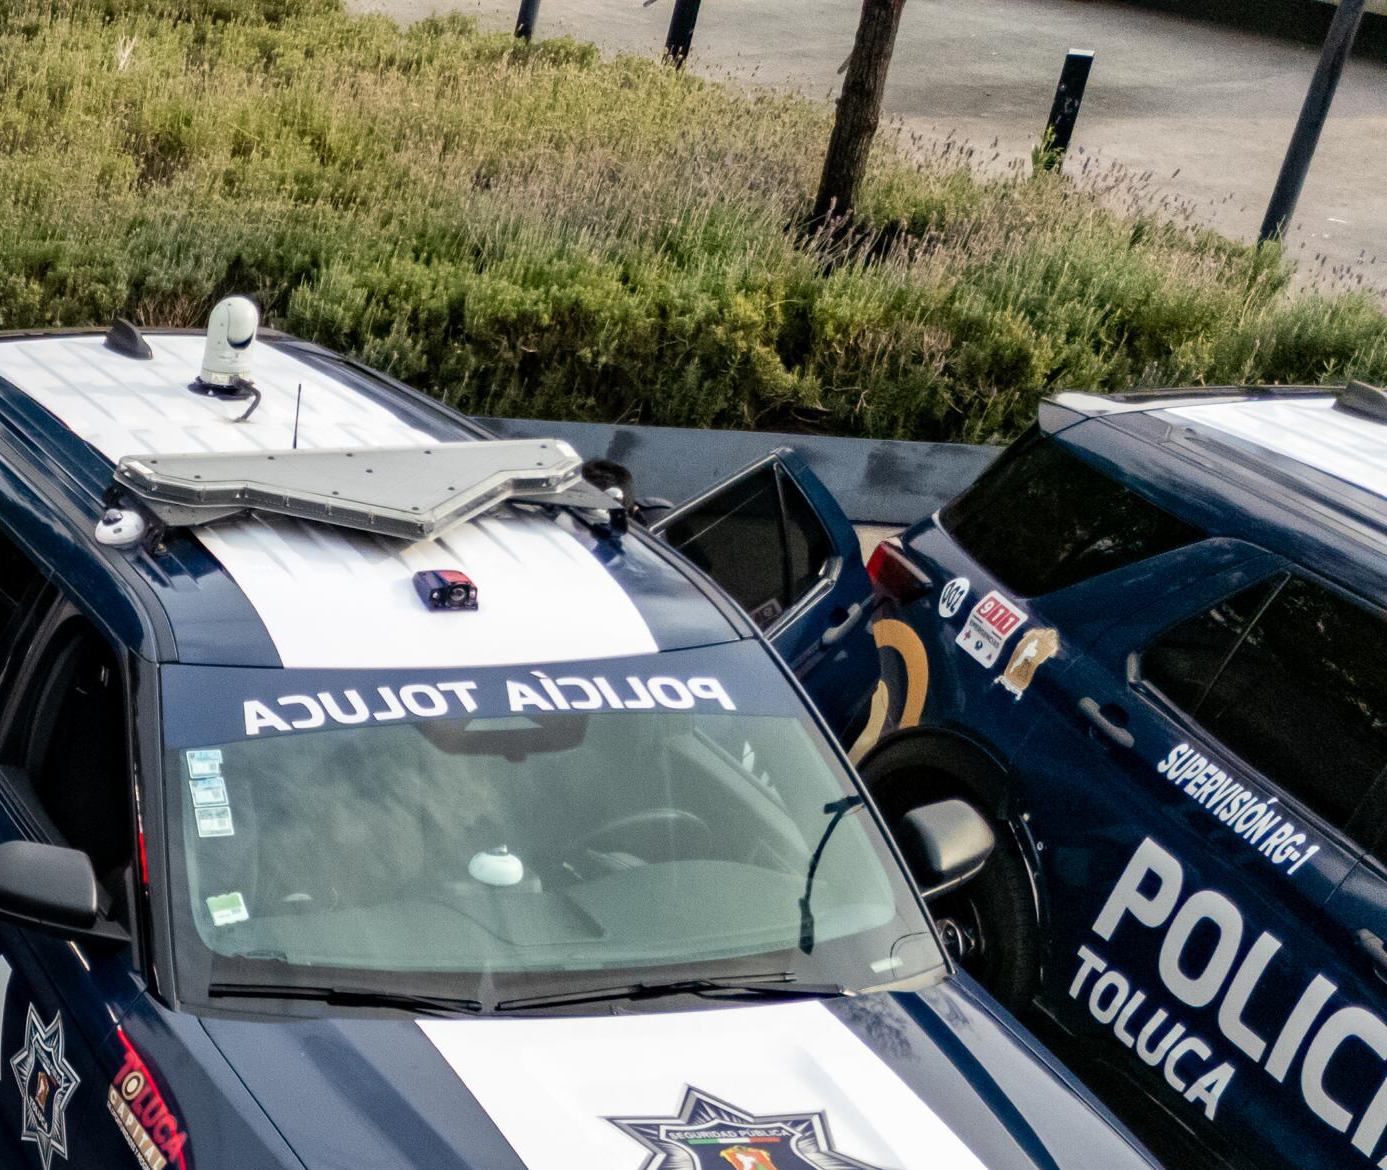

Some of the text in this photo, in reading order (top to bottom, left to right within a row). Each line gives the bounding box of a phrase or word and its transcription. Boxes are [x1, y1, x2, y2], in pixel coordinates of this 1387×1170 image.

[979, 601, 1015, 632] 911
[1157, 743, 1320, 876] SUPERVISIÓN RG-1
[1069, 945, 1235, 1121] TOLUCA
[112, 1050, 187, 1163] TOLUCA
[669, 1128, 791, 1139] SEGURIDAD PÚBLICA
